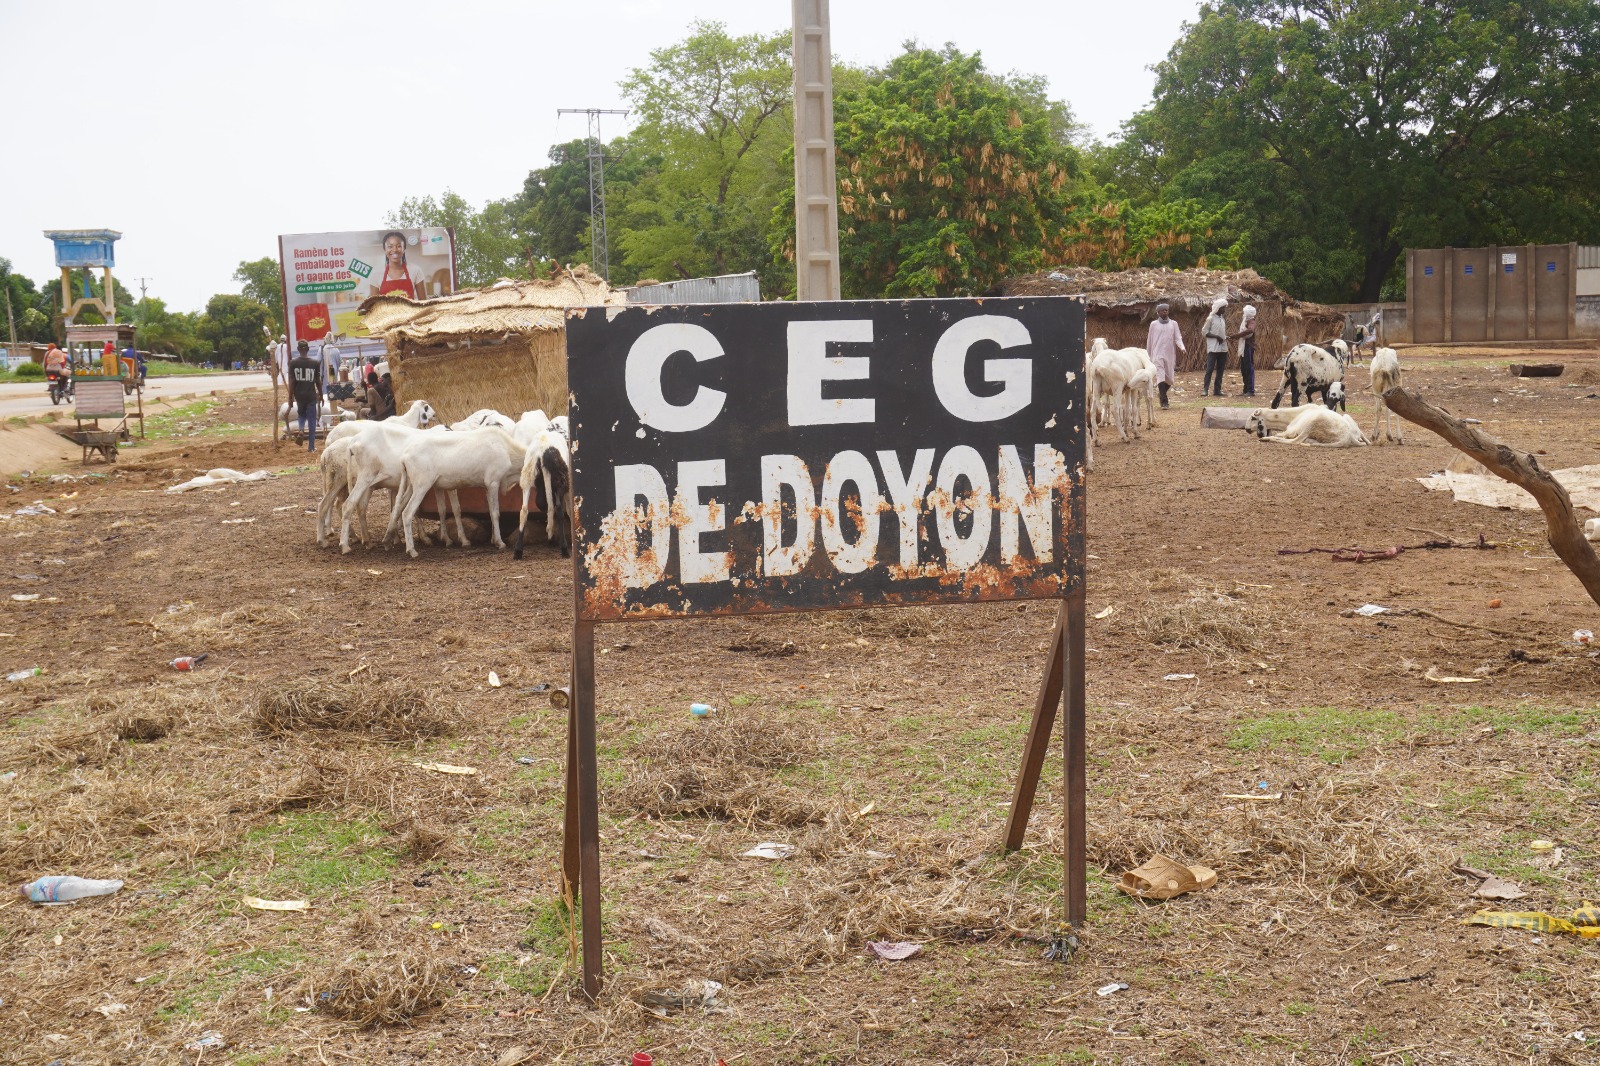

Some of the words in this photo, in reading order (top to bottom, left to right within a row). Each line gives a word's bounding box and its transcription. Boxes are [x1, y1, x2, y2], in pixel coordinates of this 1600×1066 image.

[294, 247, 328, 258] Ramène
[295, 259, 345, 270] emballages
[351, 259, 370, 275] LOTS
[296, 273, 304, 282] et
[307, 272, 333, 282] gagne
[336, 270, 351, 279] des
[613, 459, 730, 588] DE
[760, 443, 1055, 578] DOYON
